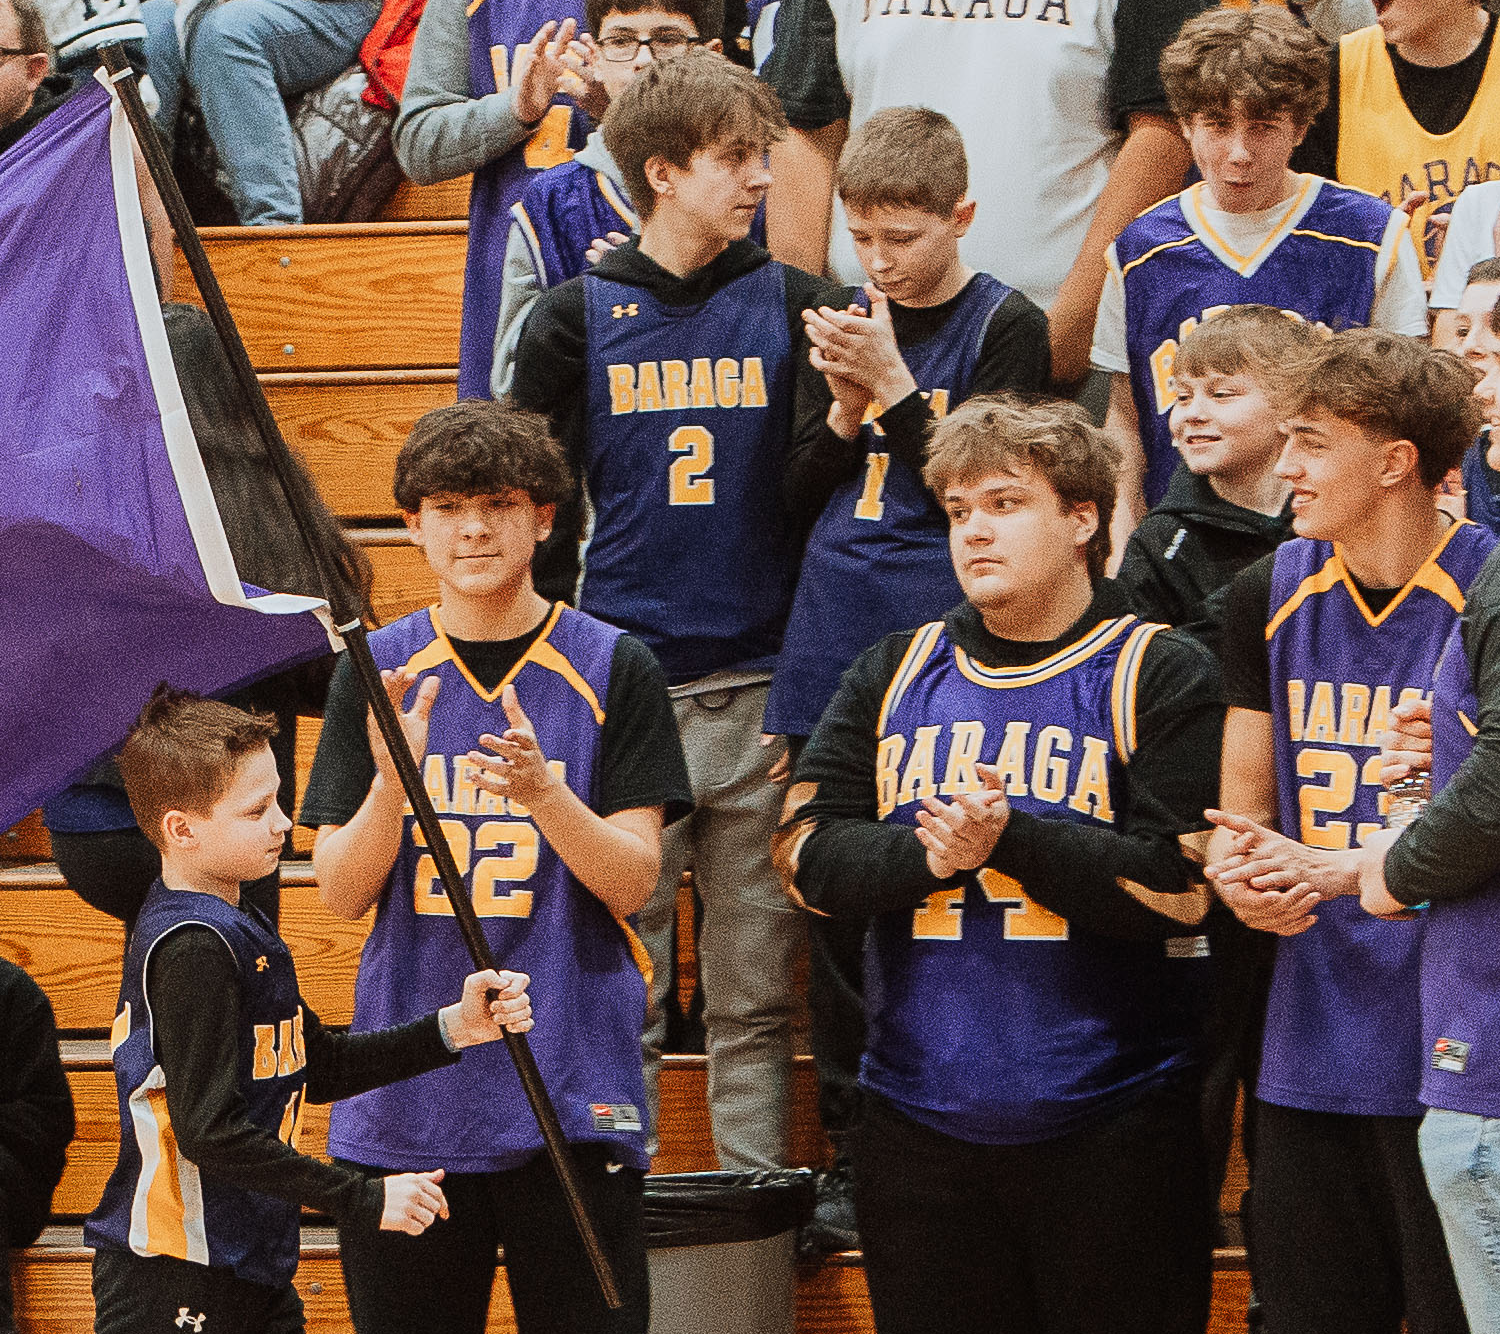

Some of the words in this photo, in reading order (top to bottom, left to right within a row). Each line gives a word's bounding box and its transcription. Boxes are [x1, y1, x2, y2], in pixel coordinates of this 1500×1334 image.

[609, 358, 768, 414] BARAGA
[670, 427, 714, 505] 2
[876, 719, 1117, 823] BARAGA
[412, 821, 539, 918] 22
